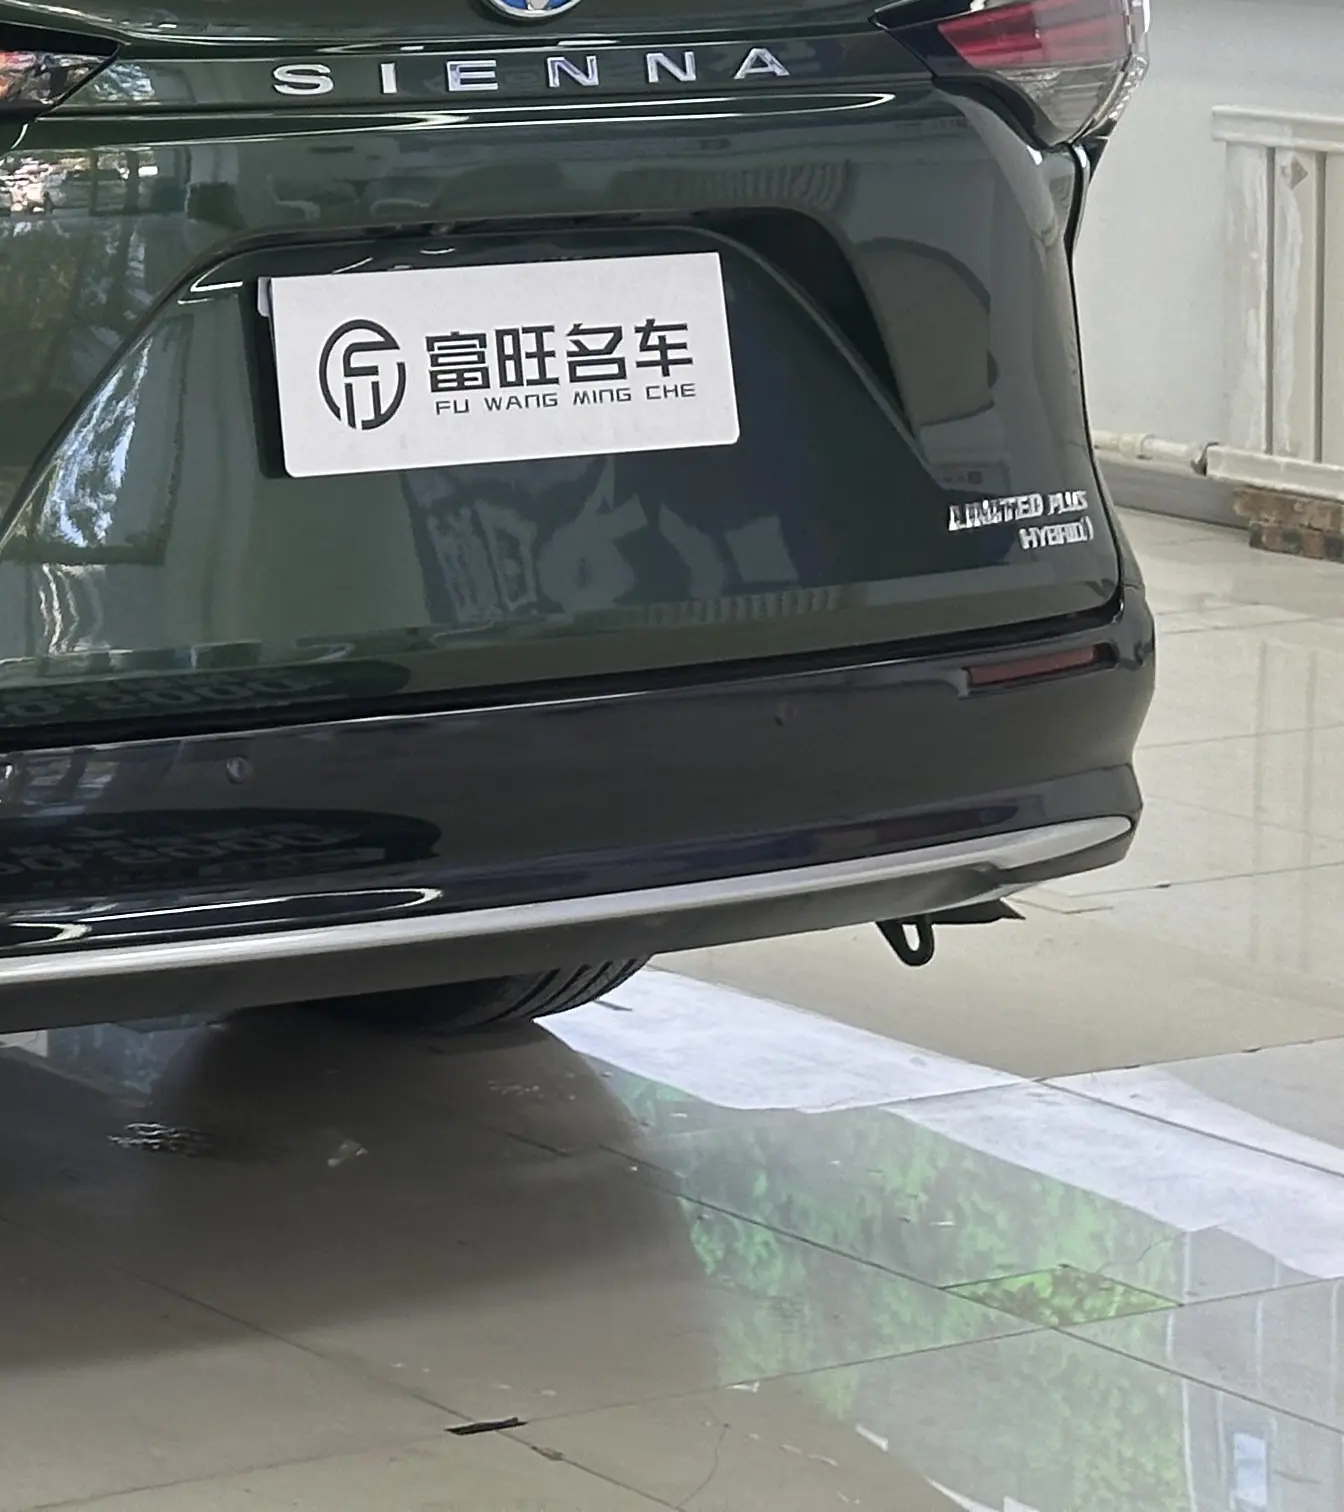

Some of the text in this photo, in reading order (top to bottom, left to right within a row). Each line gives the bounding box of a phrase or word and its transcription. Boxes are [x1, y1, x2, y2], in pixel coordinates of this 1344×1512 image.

[273, 48, 790, 96] SIENNA
[425, 318, 694, 393] 富旺名车
[435, 383, 696, 415] FU WANG MING CHE
